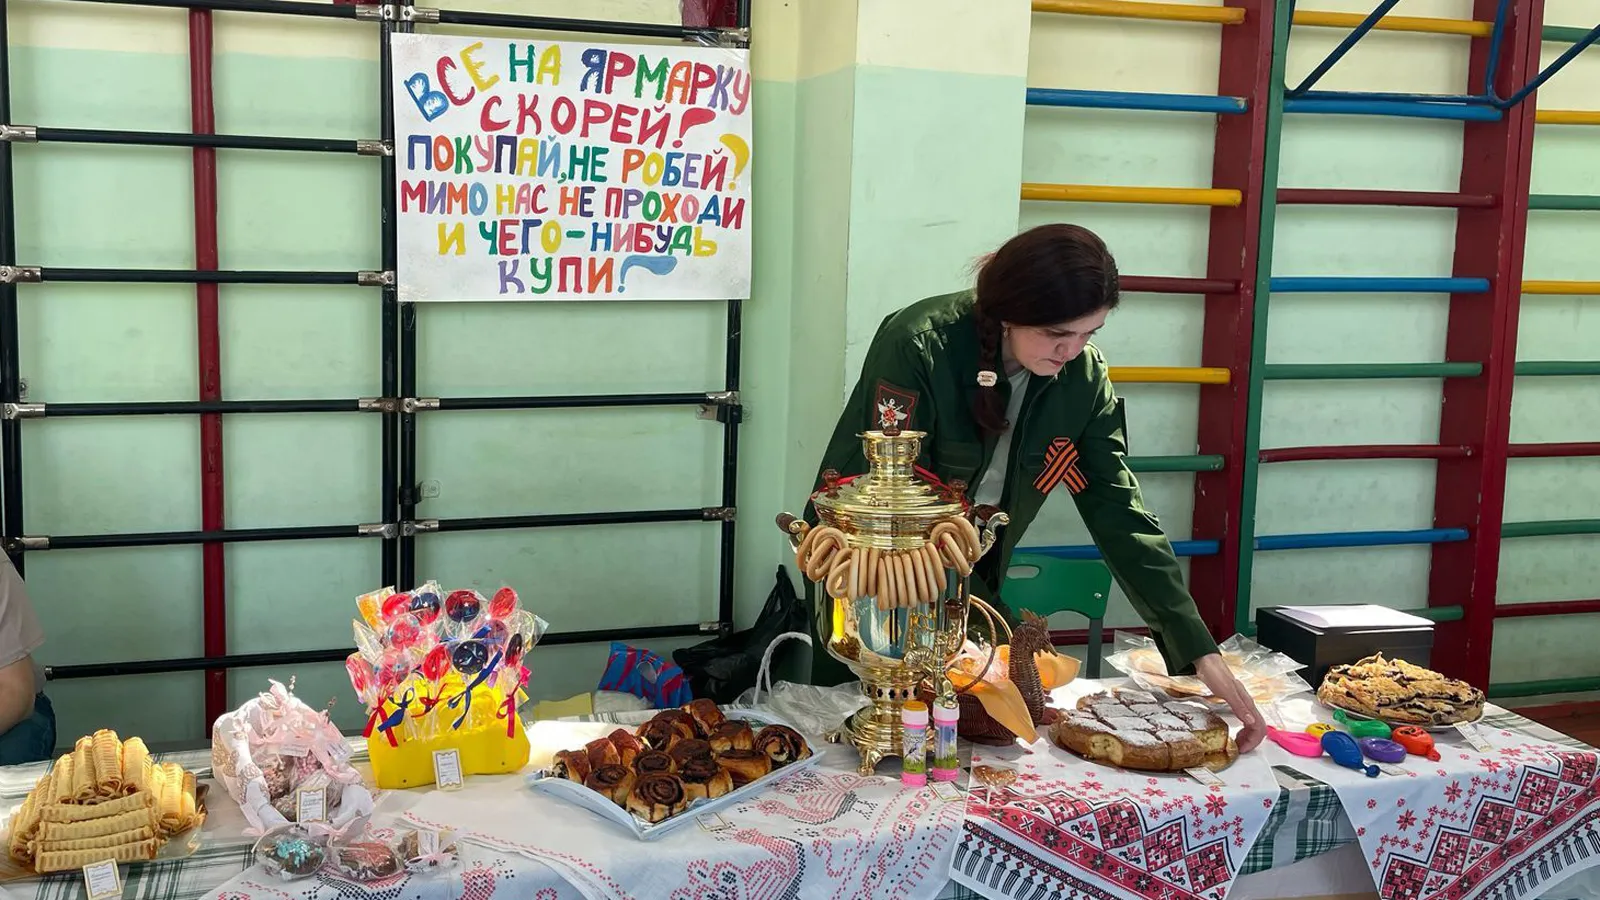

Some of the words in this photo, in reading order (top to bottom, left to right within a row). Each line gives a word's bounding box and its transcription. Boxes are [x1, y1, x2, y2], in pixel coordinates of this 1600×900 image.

[404, 41, 499, 122] ВСЕ
[509, 43, 562, 86] НА
[580, 48, 750, 115] ЯРМАРКУ
[401, 180, 488, 215] МИМО
[496, 183, 548, 215] НАС
[558, 186, 596, 217] НЕ
[605, 186, 745, 230] ПРОХОДИ
[437, 222, 466, 255] И
[479, 218, 718, 257] ЧЕГО-НИБУДЬ
